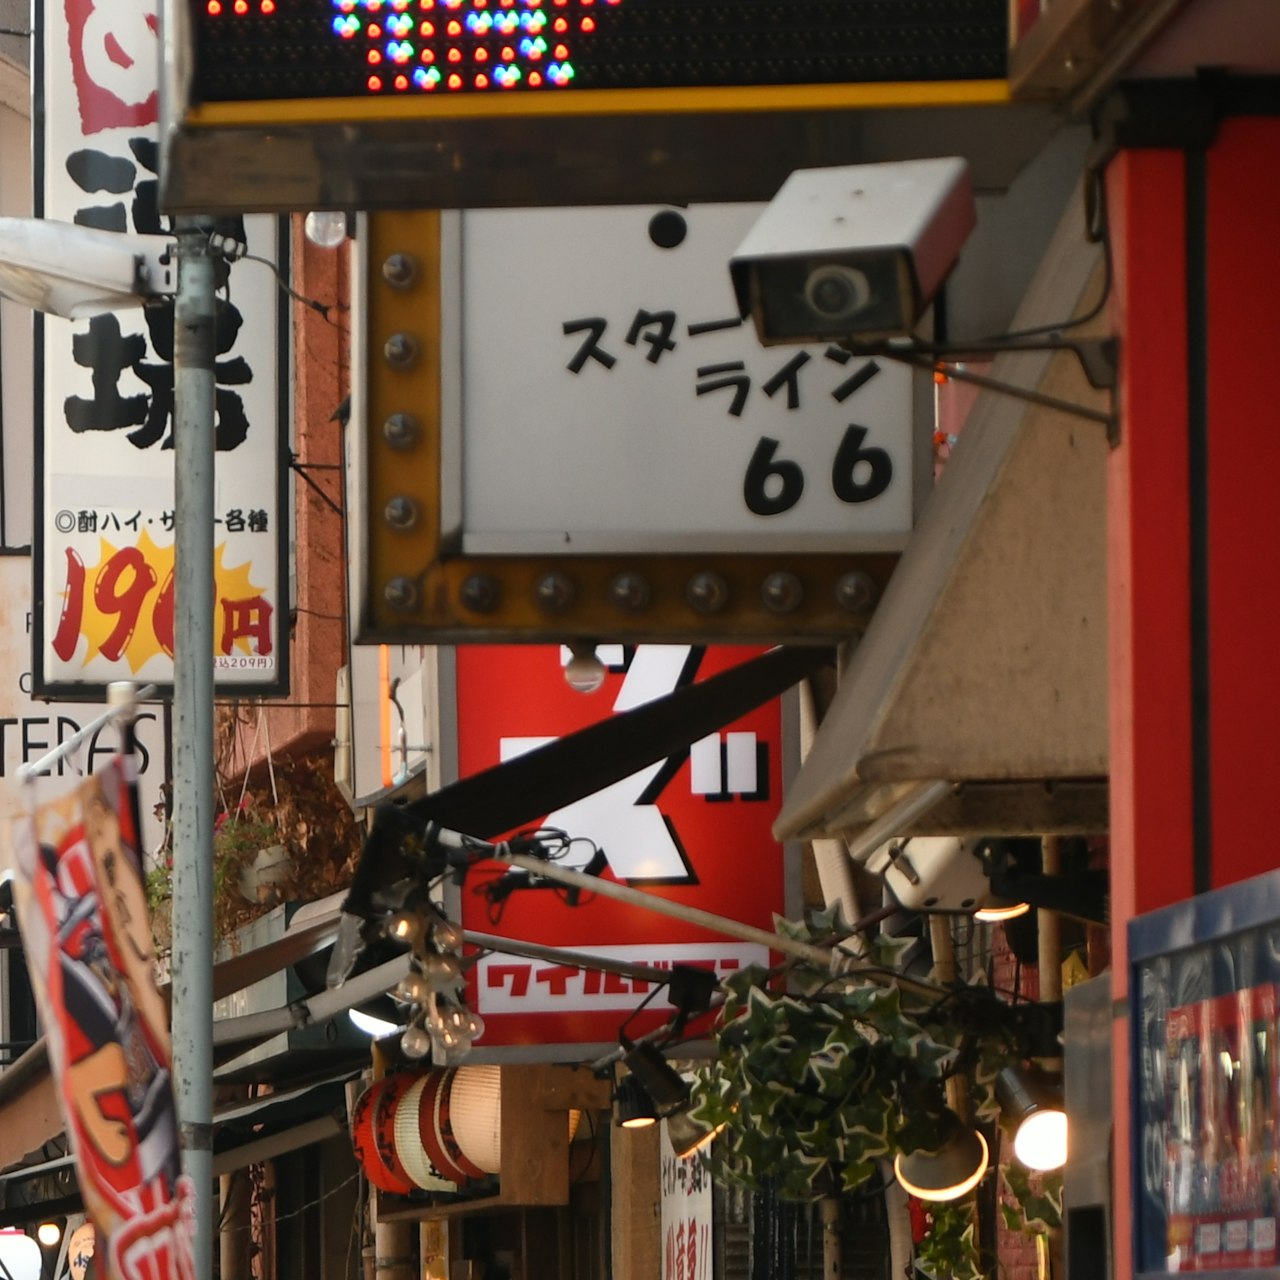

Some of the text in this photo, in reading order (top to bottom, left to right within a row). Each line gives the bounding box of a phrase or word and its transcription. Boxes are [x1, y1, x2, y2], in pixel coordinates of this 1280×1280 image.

[696, 346, 881, 417] ライン
[487, 959, 739, 997] ワイルド
